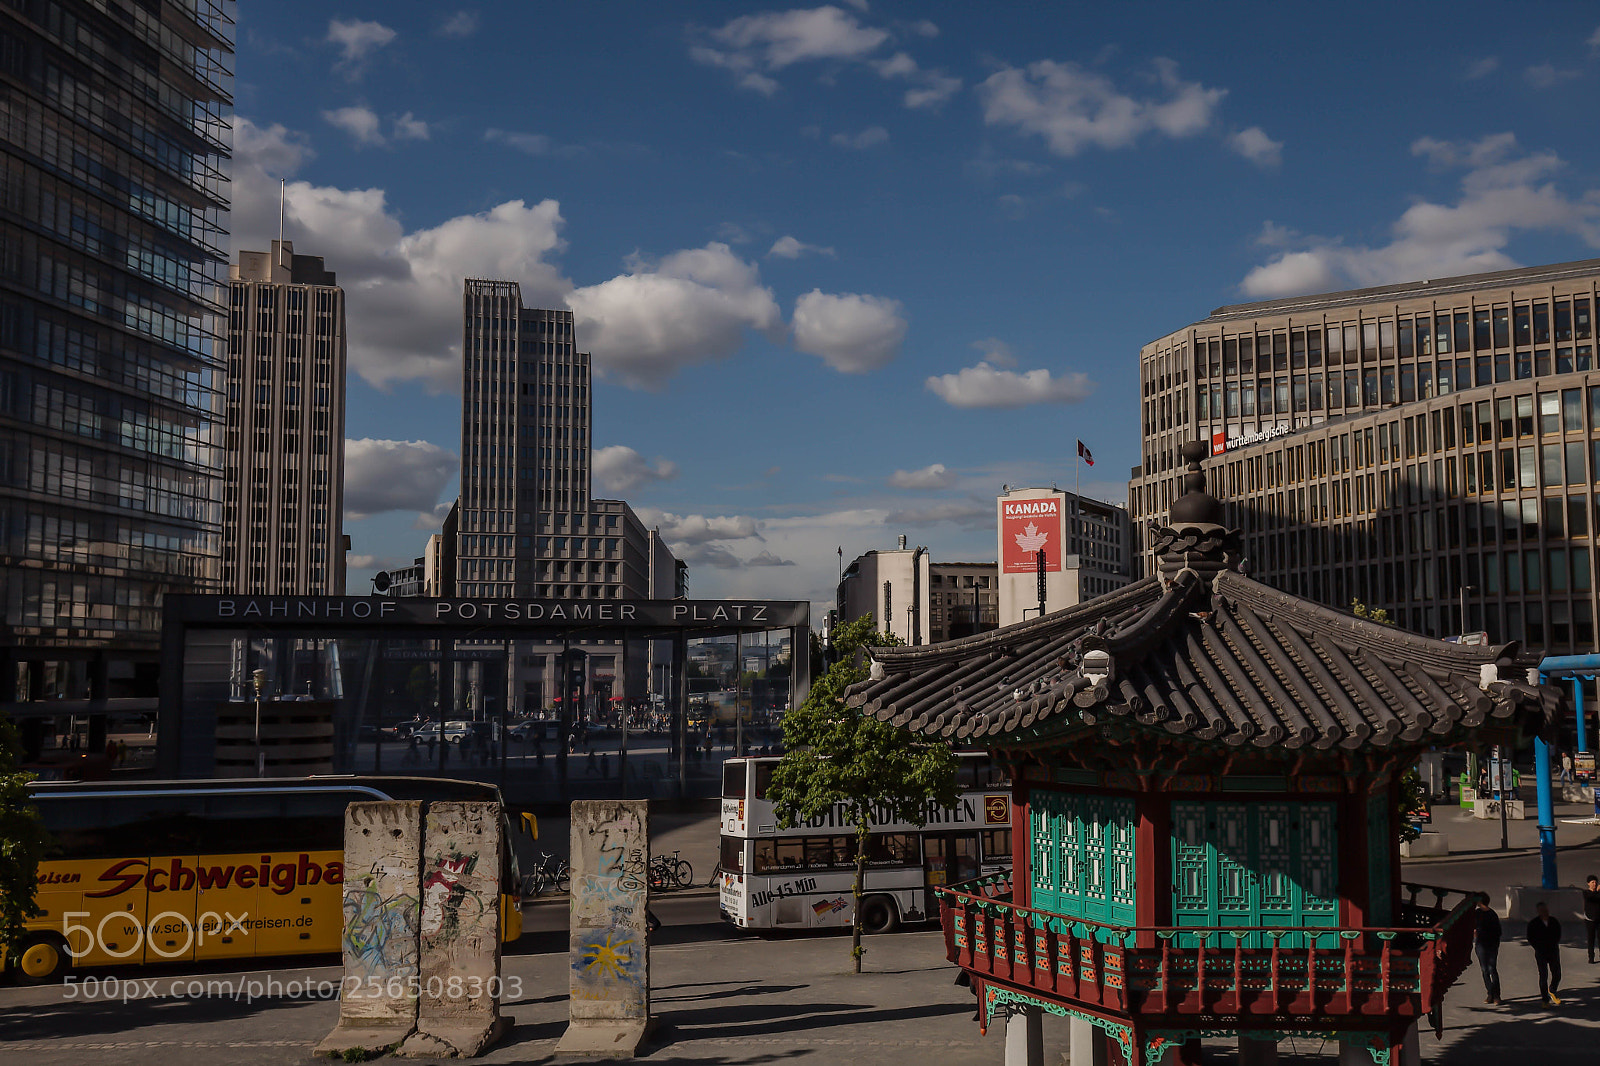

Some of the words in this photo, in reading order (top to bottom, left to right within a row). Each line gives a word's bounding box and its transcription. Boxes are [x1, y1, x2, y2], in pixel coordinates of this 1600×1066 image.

[1225, 424, 1289, 450] württembergische
[1005, 502, 1057, 515] KANADA
[218, 600, 396, 618] BAHNHOF
[435, 602, 637, 620] POTSDAMER
[672, 604, 768, 622] PLATZ
[751, 890, 775, 908] Alle
[777, 882, 793, 899] 15
[795, 878, 817, 894] Min
[124, 916, 313, 936] www.schweighartreisen.de
